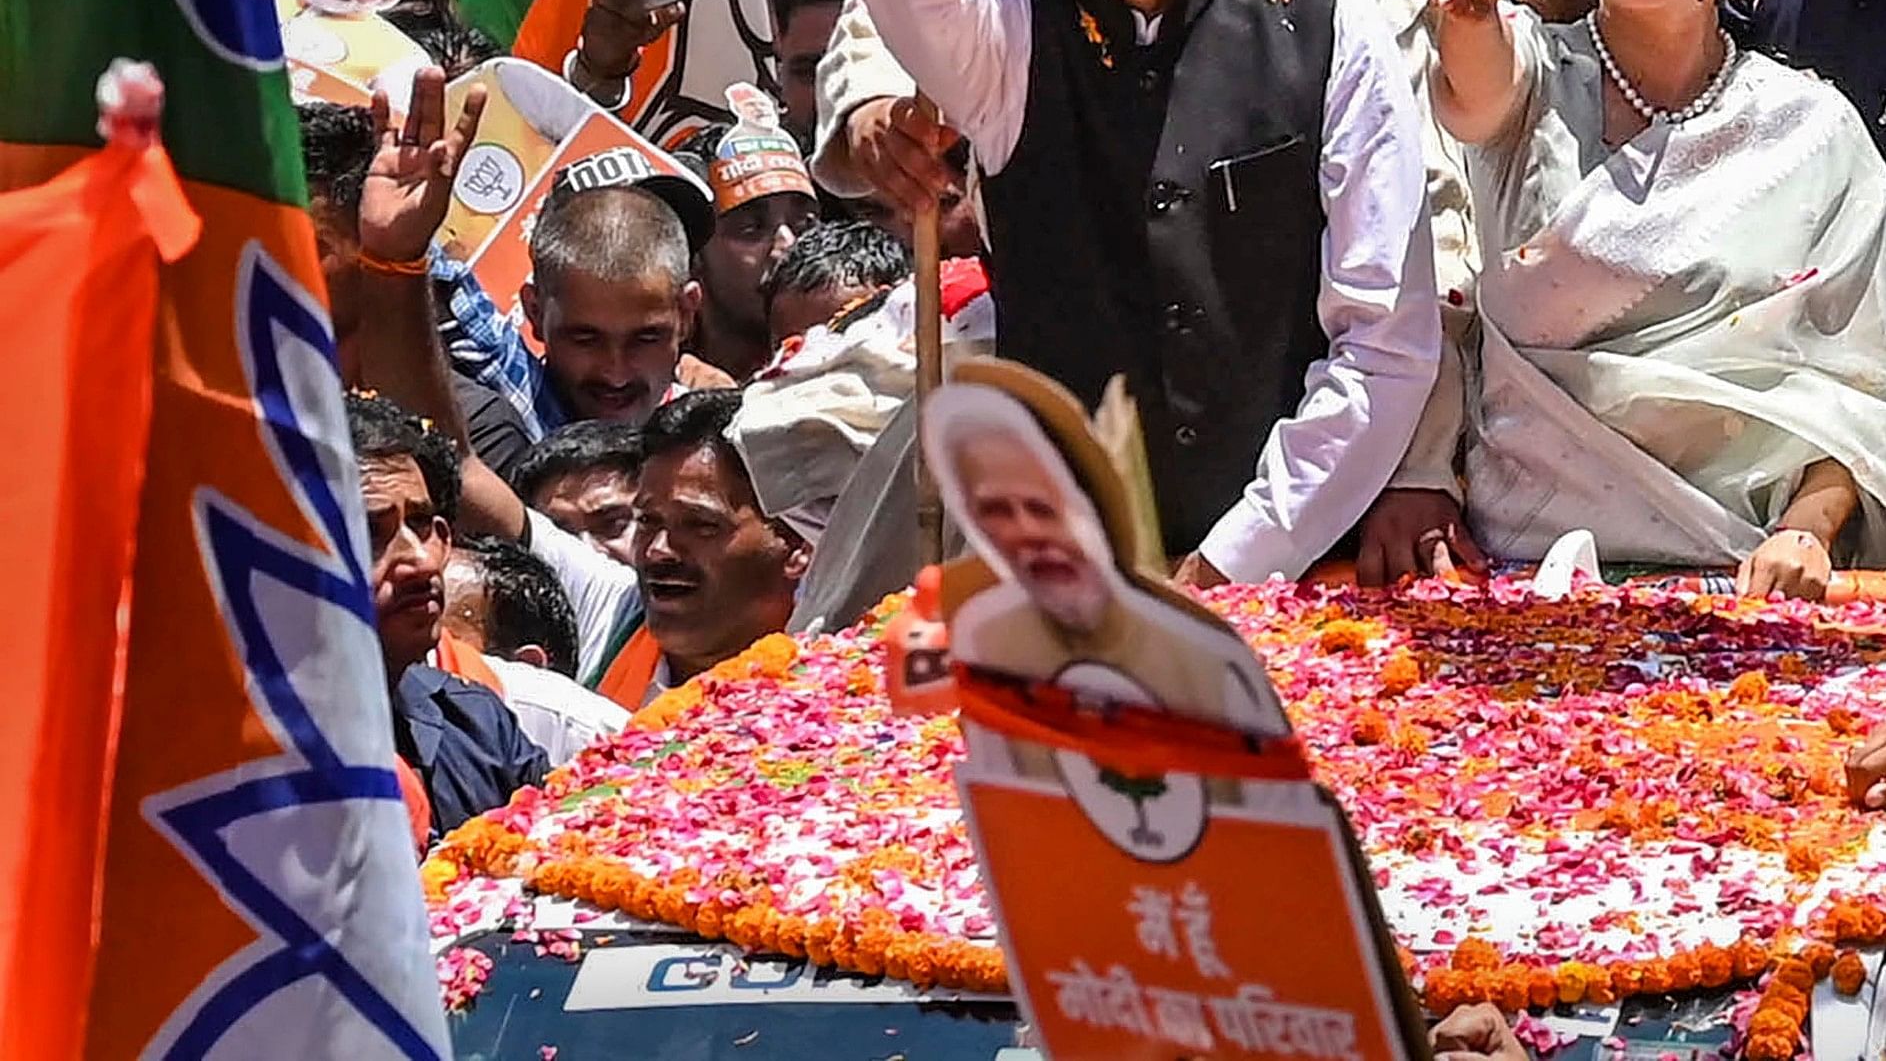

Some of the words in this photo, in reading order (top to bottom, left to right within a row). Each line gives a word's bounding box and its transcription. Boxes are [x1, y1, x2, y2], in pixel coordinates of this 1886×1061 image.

[1125, 883, 1180, 962] मैं
[1044, 958, 1156, 1036] मोदी
[1145, 985, 1216, 1051] का
[1208, 983, 1363, 1061] परिवार
